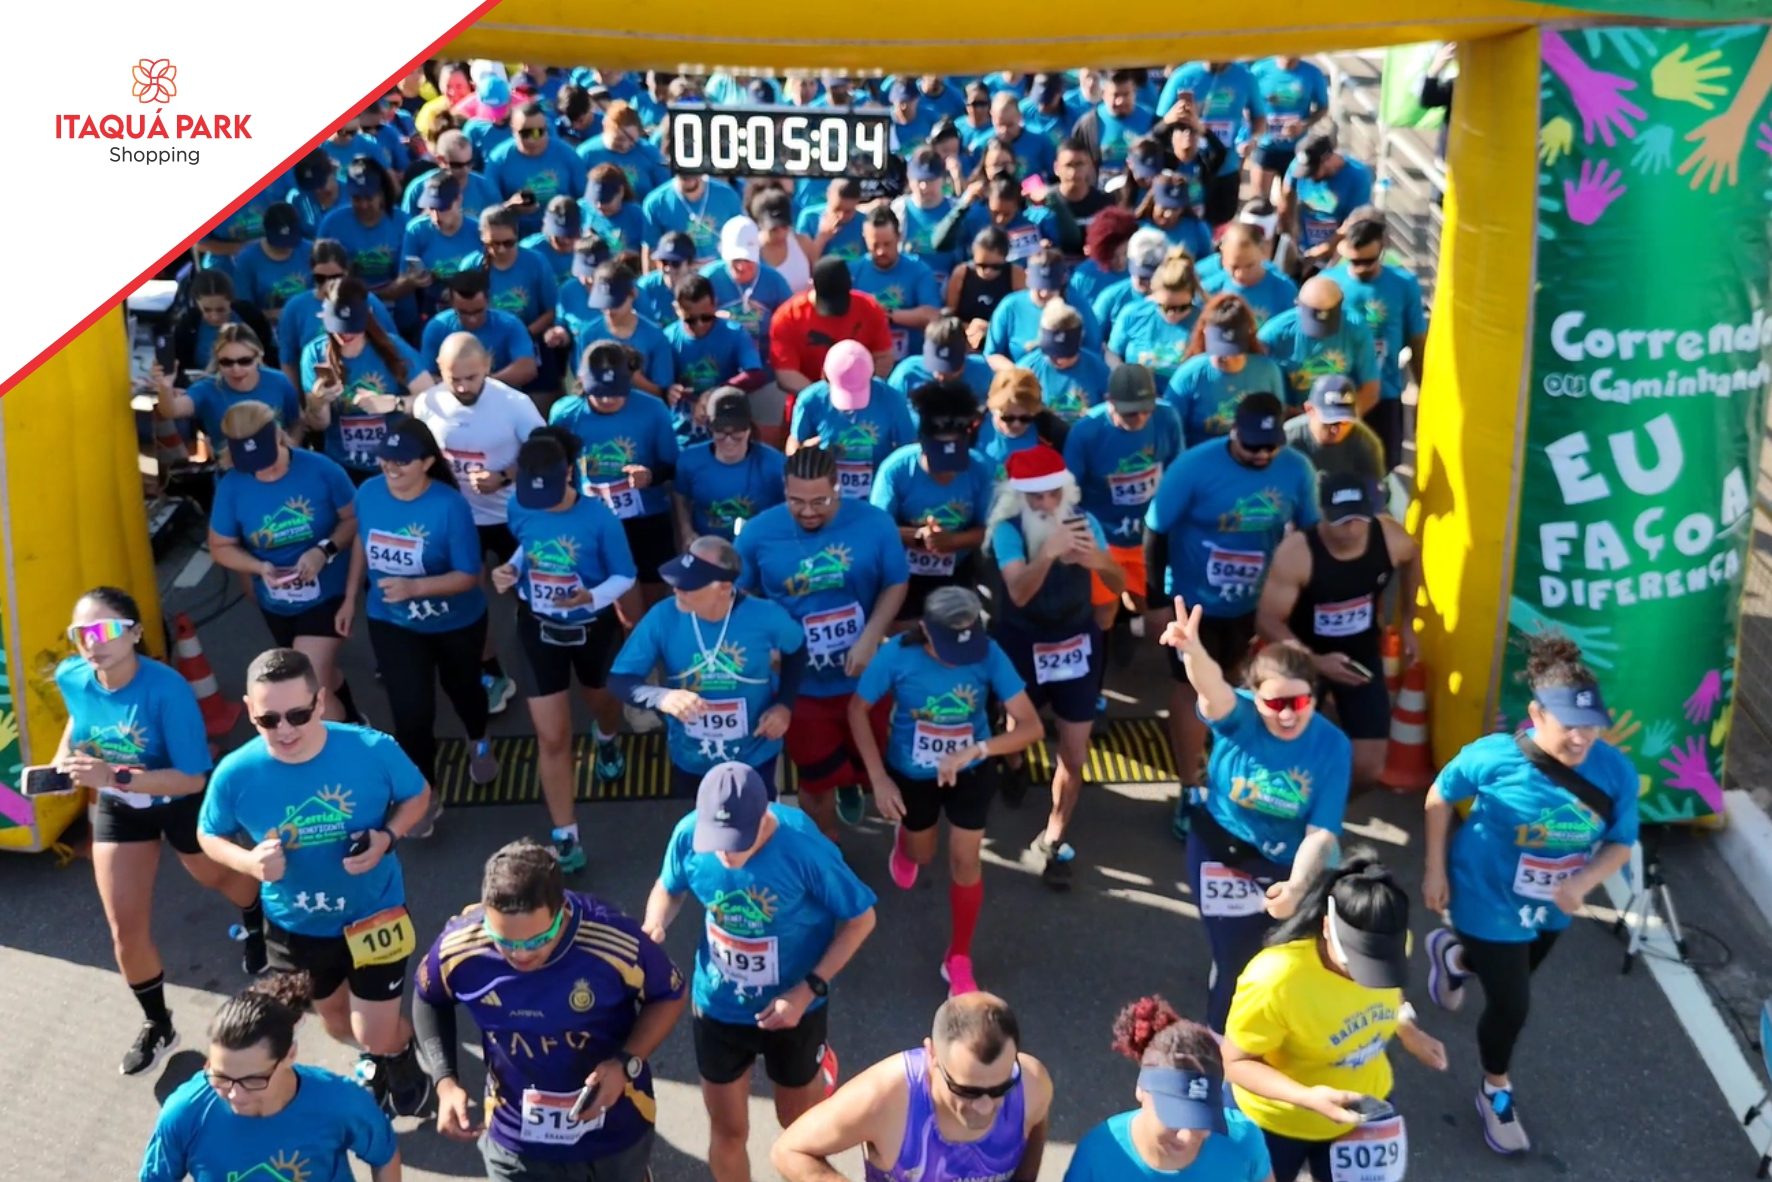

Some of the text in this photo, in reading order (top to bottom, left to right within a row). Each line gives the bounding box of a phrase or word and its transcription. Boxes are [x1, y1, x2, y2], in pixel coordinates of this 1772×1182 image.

[674, 113, 884, 172] 00:05:04
[1544, 412, 1684, 505] EU
[840, 472, 871, 487] 082
[1539, 466, 1749, 572] FAÇO A
[369, 546, 414, 567] 5445
[1539, 548, 1739, 611] DIFERENÇA
[808, 618, 858, 643] 5168
[1319, 610, 1368, 626] 5275
[1038, 650, 1083, 670] 5249
[363, 922, 404, 952] 101
[528, 1106, 589, 1130] 519
[1336, 1141, 1399, 1169] 5029
